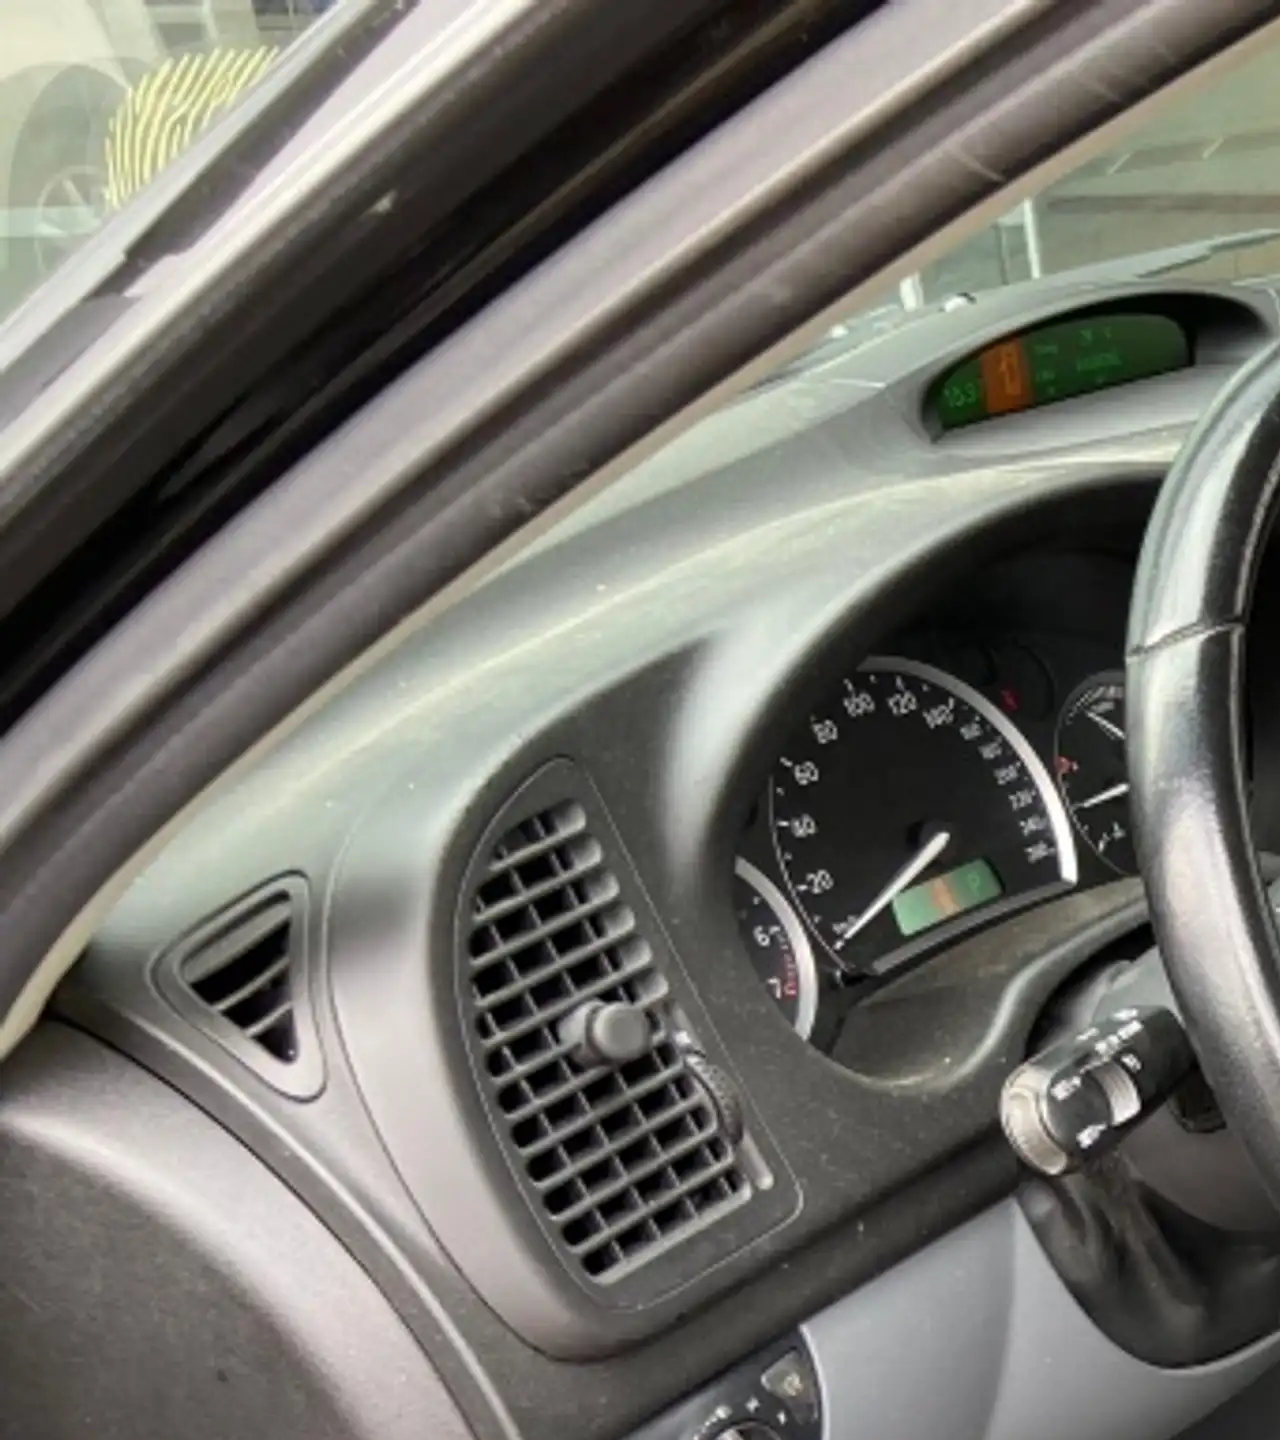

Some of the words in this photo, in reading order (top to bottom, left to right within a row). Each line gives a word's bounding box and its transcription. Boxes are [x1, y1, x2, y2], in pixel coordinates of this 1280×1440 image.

[843, 692, 876, 718] 100
[887, 691, 918, 715] 120
[922, 704, 954, 730] 140
[812, 718, 839, 745] 80
[793, 760, 820, 786] 60
[806, 869, 834, 894] 20
[752, 925, 771, 947] 6
[766, 976, 782, 1000] 7
